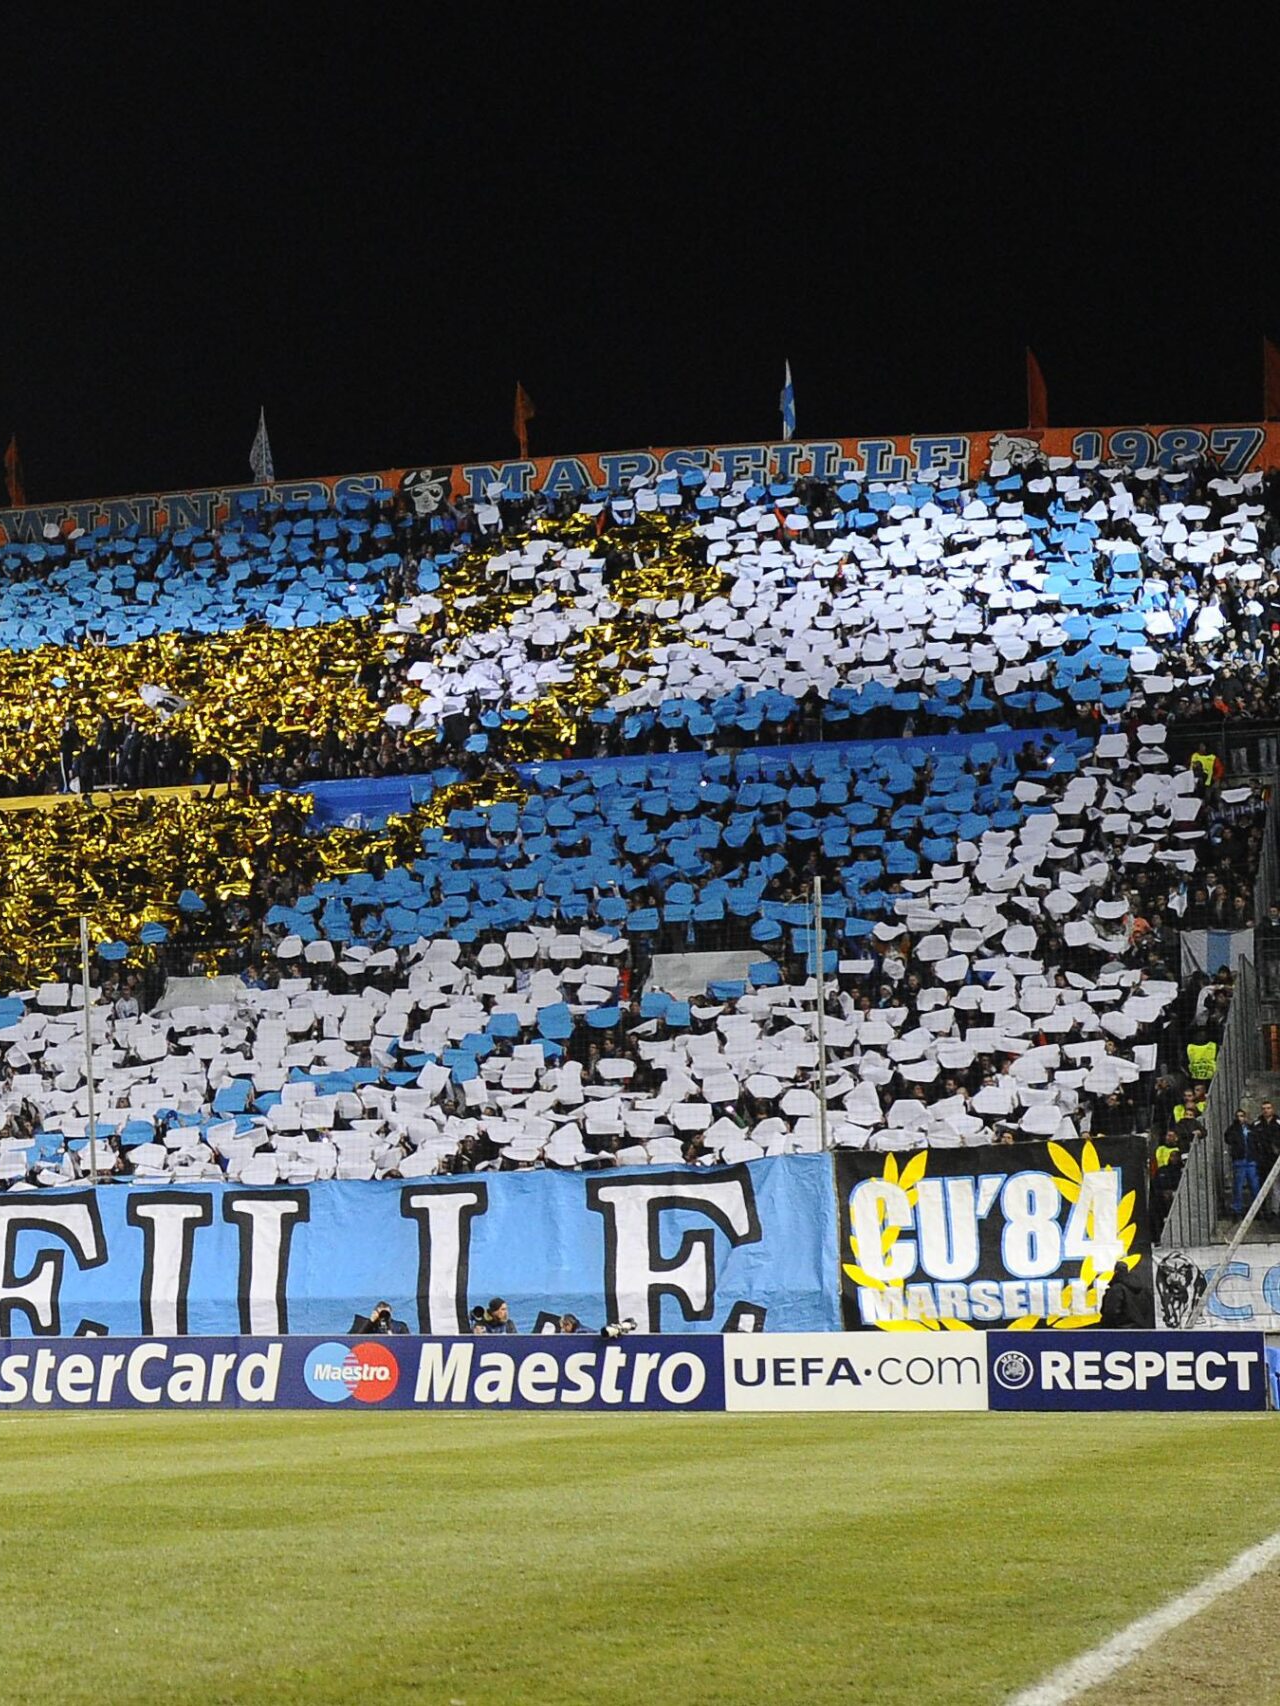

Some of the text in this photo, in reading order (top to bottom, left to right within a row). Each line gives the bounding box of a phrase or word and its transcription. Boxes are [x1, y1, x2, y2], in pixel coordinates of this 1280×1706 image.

[463, 436, 970, 502] MARSEILLE
[1073, 428, 1265, 477] 1987
[313, 1363, 391, 1381] Maestro
[414, 1343, 707, 1404] Maestro
[1041, 1351, 1259, 1390] RESPECT
